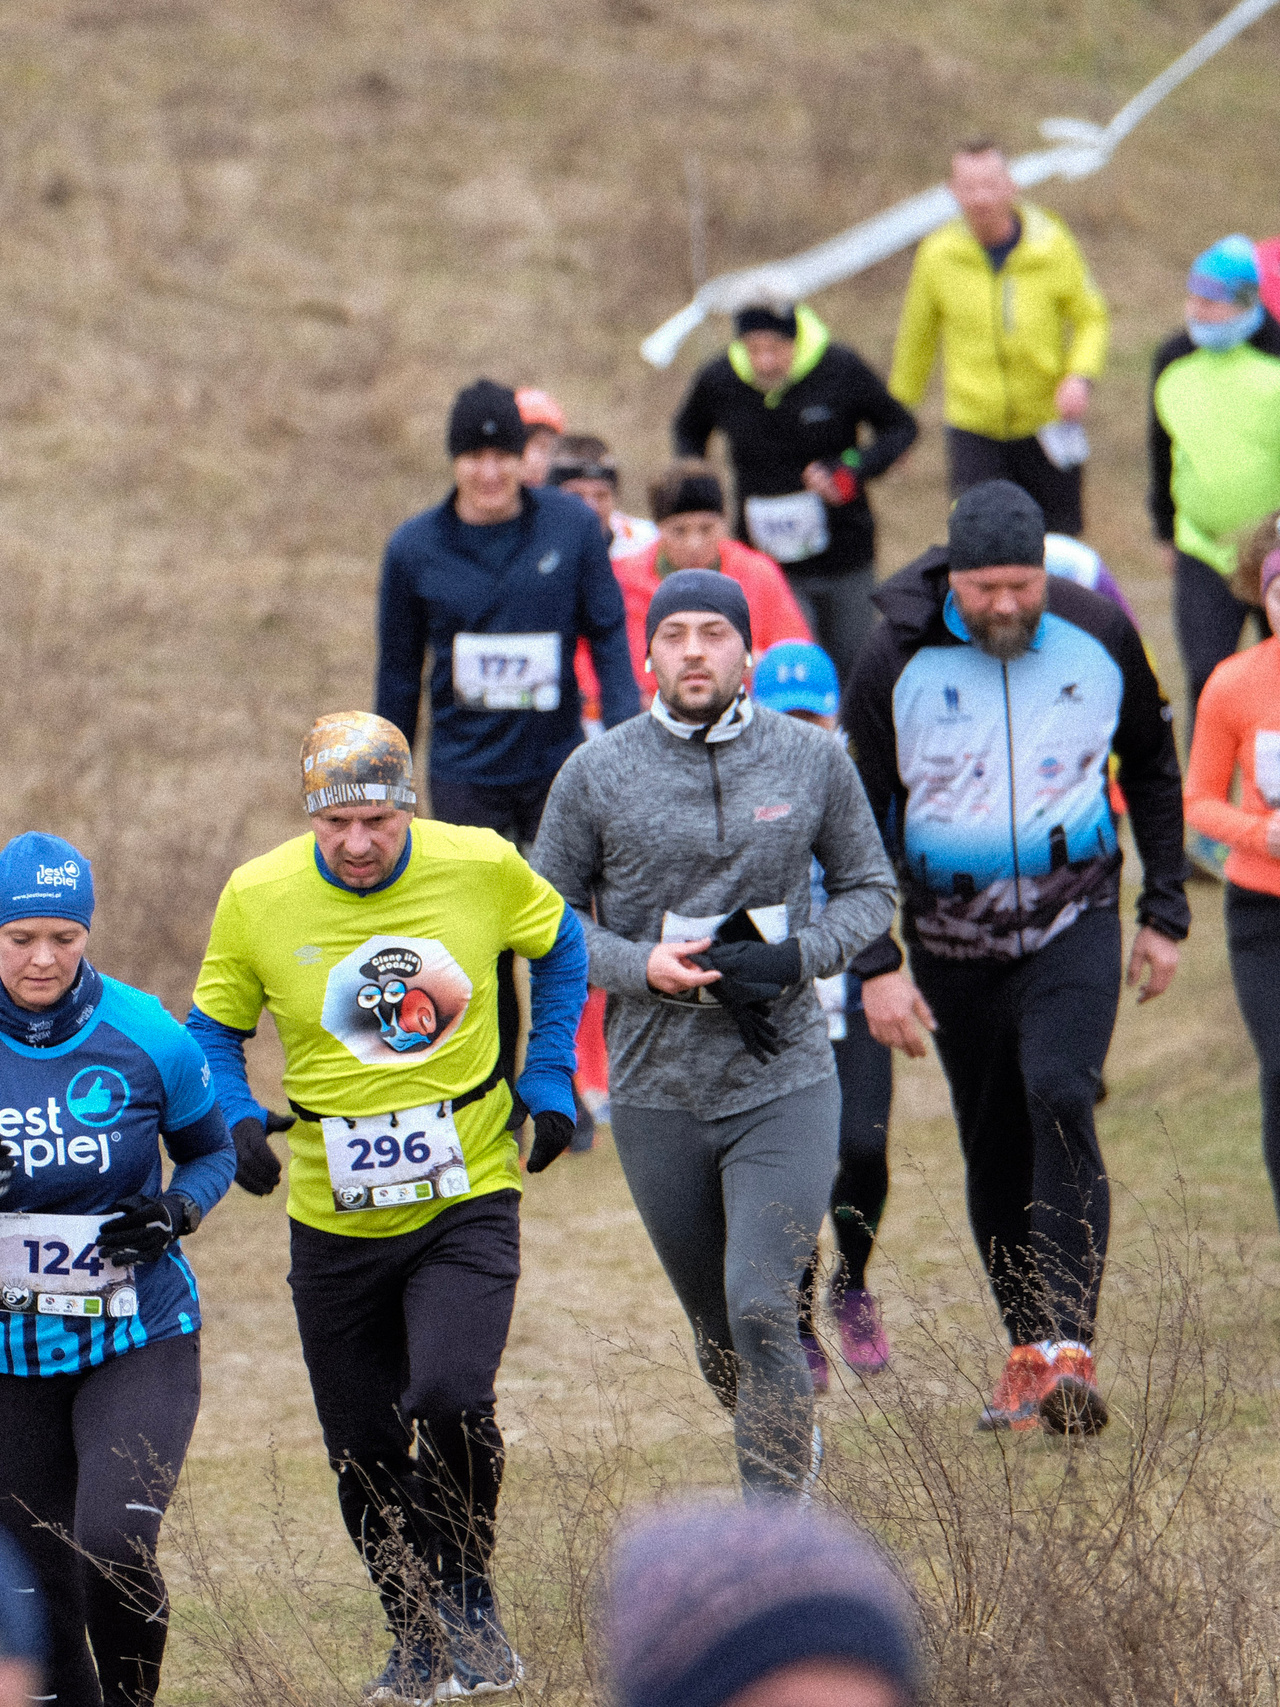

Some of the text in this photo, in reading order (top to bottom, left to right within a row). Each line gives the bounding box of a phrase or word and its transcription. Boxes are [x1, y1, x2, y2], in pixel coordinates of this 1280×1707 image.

[36, 871, 77, 891] Lepiej
[39, 864, 65, 879] Jest
[347, 1130, 431, 1171] 296
[23, 1239, 105, 1277] 124
